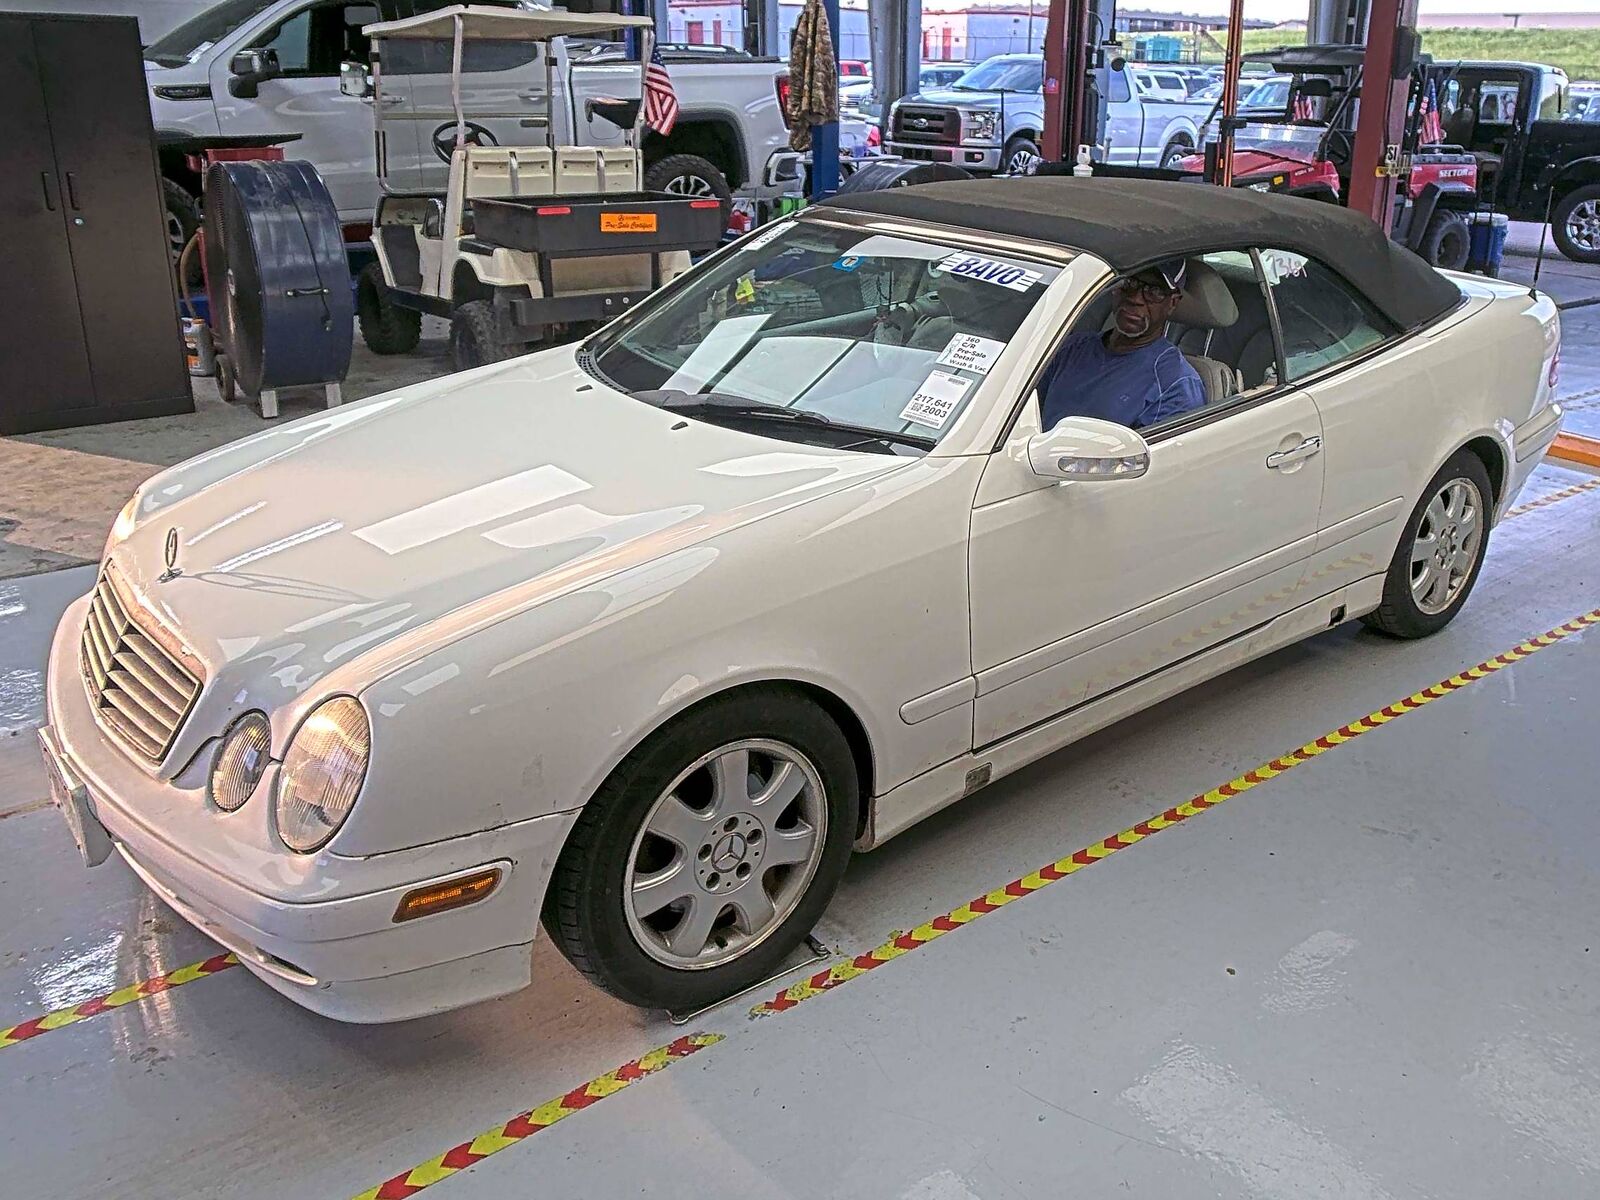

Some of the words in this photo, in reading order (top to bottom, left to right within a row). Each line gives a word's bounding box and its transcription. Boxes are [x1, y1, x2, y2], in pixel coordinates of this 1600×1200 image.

[950, 257, 1026, 285] BAVO
[966, 336, 981, 344] 360
[953, 353, 976, 362] Detail
[957, 347, 987, 359] Pre-Sale
[949, 359, 967, 367] Wash
[975, 365, 987, 373] Vac
[914, 393, 953, 410] 217,641
[922, 405, 948, 419] 2003
